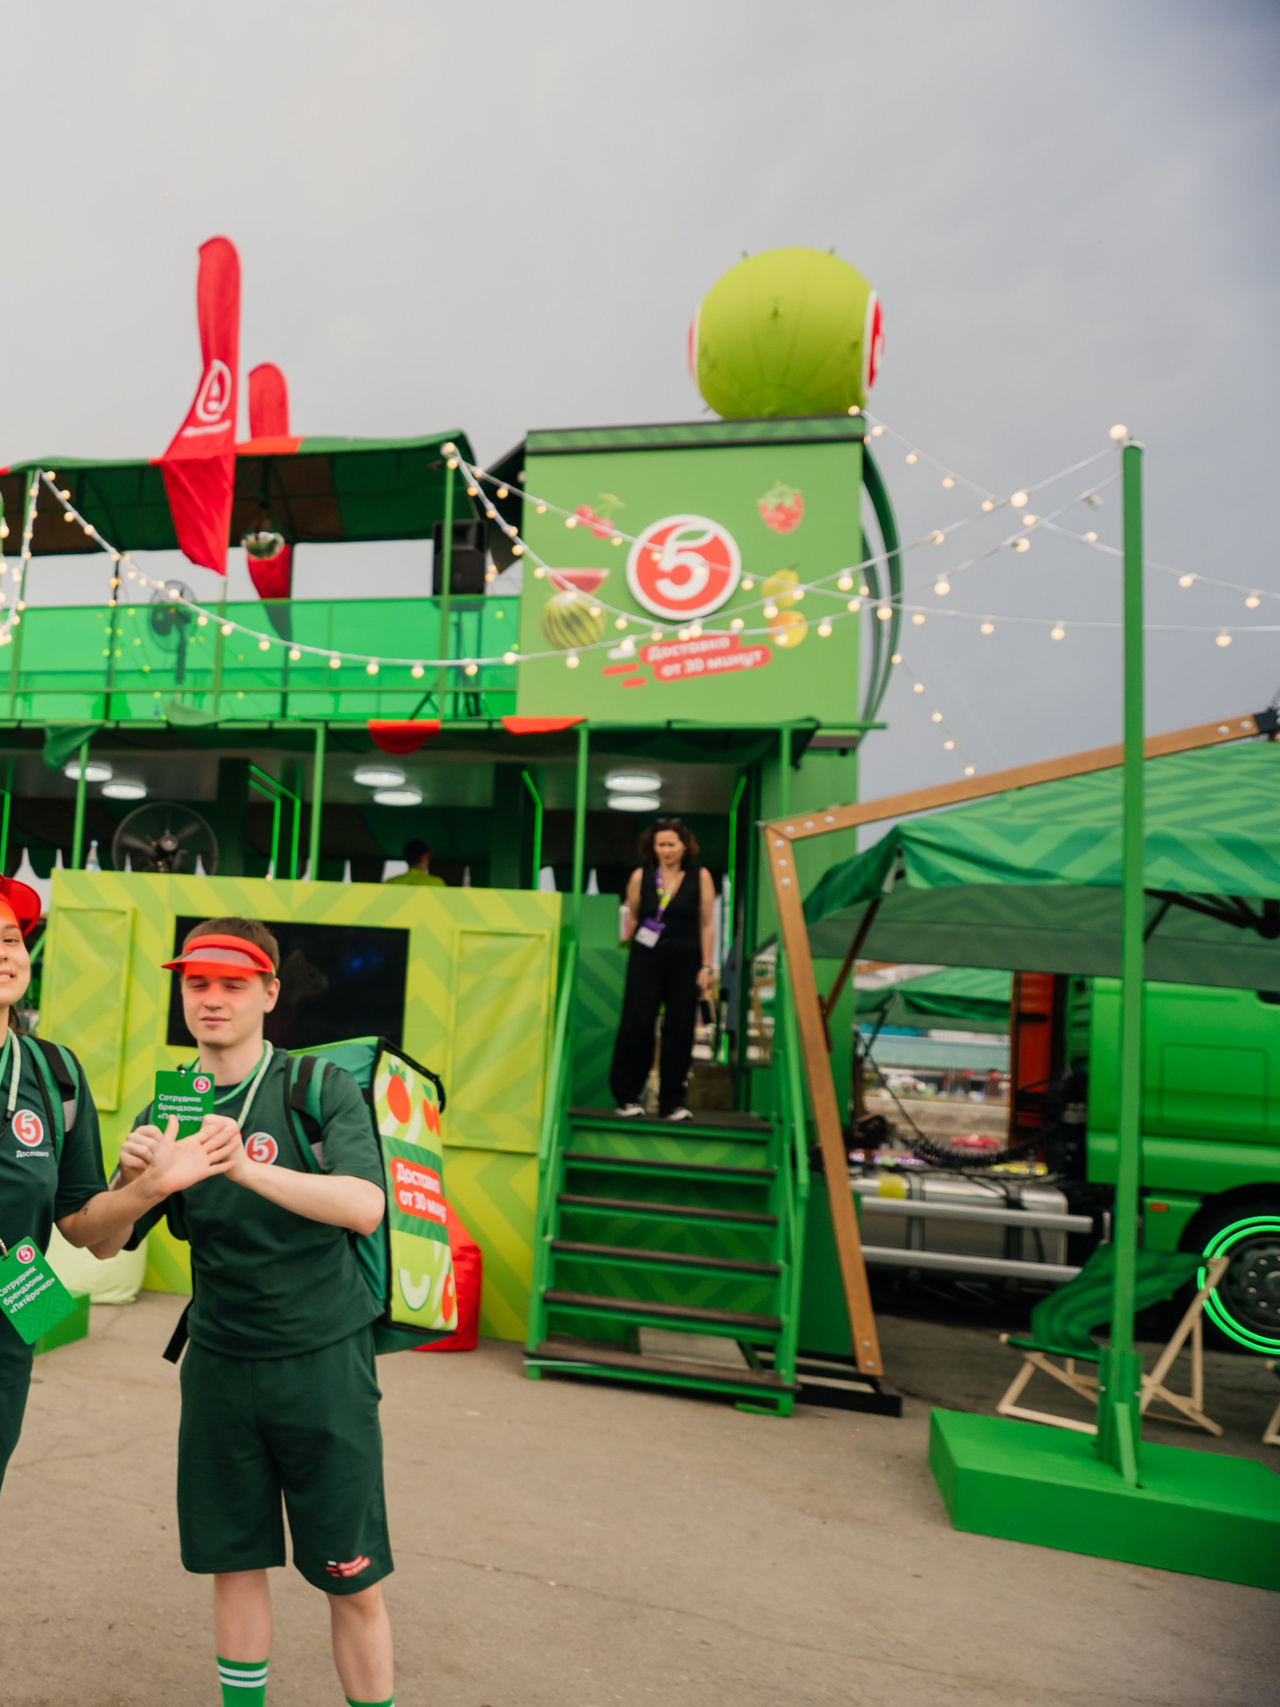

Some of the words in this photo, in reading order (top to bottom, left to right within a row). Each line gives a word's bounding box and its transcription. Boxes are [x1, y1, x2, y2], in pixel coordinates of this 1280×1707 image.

[647, 636, 731, 662] Доставка
[660, 661, 682, 677] от
[684, 658, 704, 674] 30
[706, 649, 763, 671] минут
[158, 1093, 202, 1103] Сотрудник
[158, 1103, 203, 1112] брендзоны
[399, 1190, 414, 1207] от
[413, 1191, 427, 1212] 30
[3, 1273, 44, 1306] брендзоны
[10, 1277, 56, 1314] «Пятёрочка»
